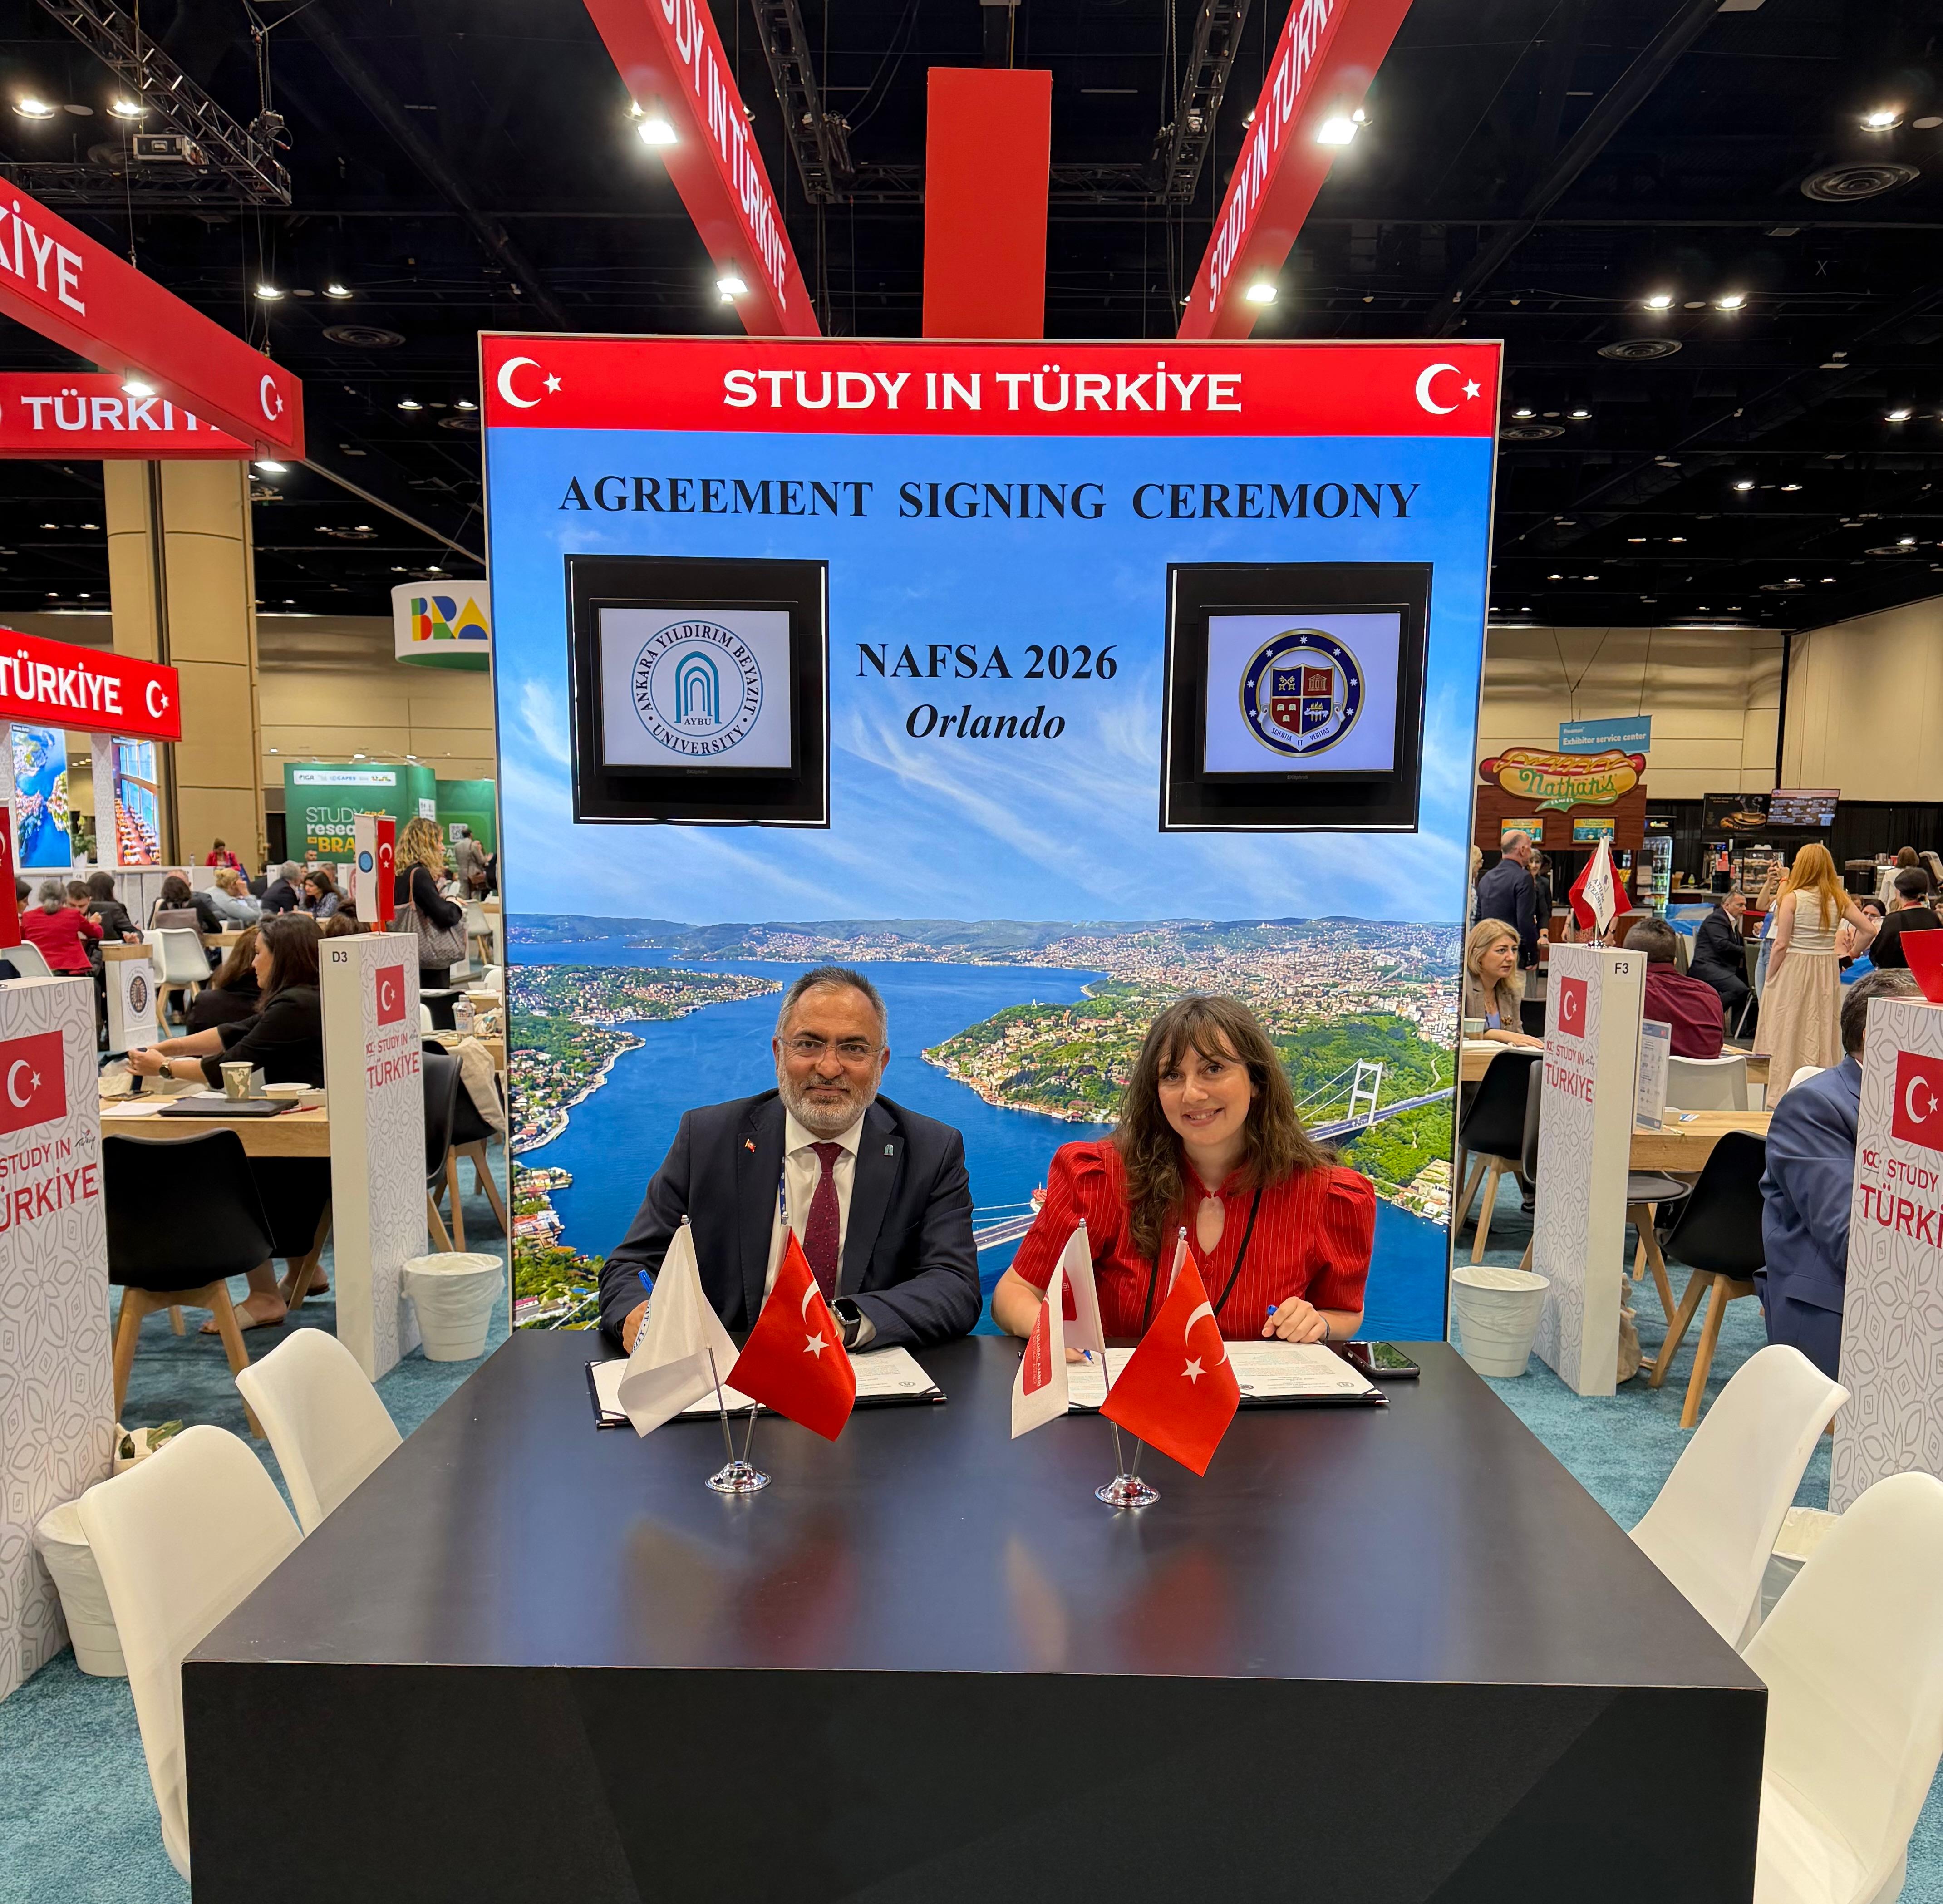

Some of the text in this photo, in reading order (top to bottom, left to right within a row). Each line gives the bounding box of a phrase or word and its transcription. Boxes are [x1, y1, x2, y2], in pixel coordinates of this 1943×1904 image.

[1210, 0, 1334, 312] STUDY IN TÜRK
[708, 45, 727, 162] IN
[729, 101, 786, 312] TÜRKİYE
[724, 361, 1242, 413] STUDY IN TÜRKİYE
[558, 476, 1421, 520] AGREEMENT SIGNING CEREMONY
[636, 624, 759, 716] ANKARA YILDIRIM BEYAZIT
[856, 643, 1118, 679] NAFSA 2026
[0, 649, 123, 716] TÜRKİYE
[652, 723, 745, 755] UNIVERSITY
[684, 718, 712, 726] AYBU
[906, 704, 1066, 739] Orlando
[1271, 728, 1292, 742] SCIENTIA
[1309, 727, 1330, 741] VERITAS
[1563, 733, 1647, 746] Exhibitor service center
[1519, 768, 1617, 797] Nathan's
[332, 951, 348, 963] D3
[1614, 963, 1629, 974] F3
[377, 1035, 399, 1053] STUDY
[401, 1032, 408, 1046] IN
[1556, 1044, 1576, 1063] STUDY
[1577, 1051, 1584, 1066] IN
[366, 1050, 420, 1090] TÜRKİYE
[1545, 1060, 1594, 1103] TÜRKİYE
[0, 1143, 51, 1178] STUDY
[55, 1137, 71, 1160] IN
[1887, 1158, 1940, 1193] STUDY
